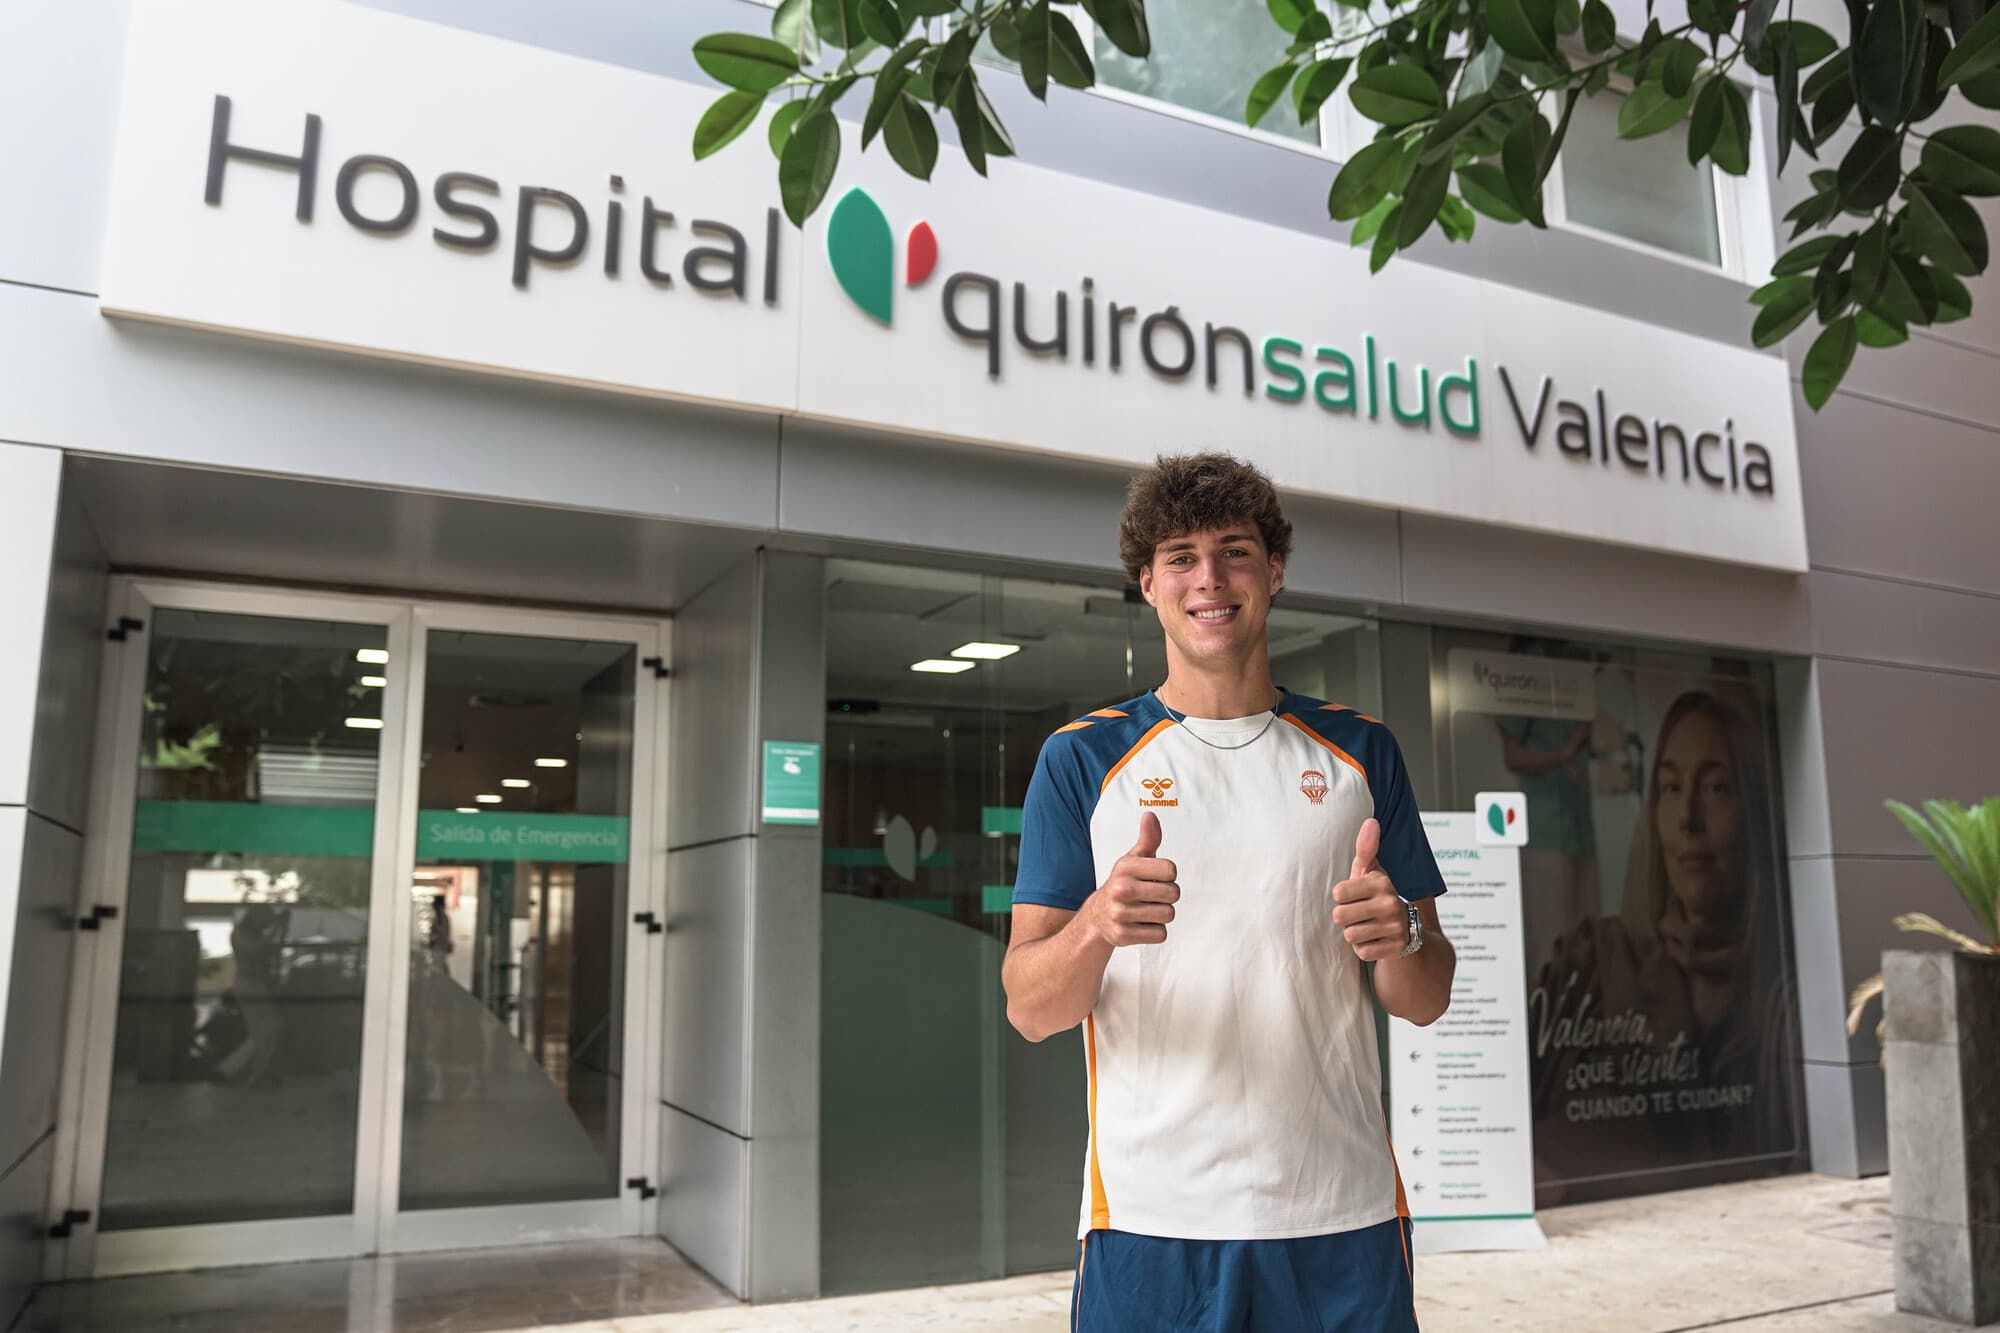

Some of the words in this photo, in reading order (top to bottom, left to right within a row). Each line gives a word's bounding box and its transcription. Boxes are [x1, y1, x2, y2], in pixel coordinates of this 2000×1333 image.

[204, 94, 781, 308] Hospital
[942, 272, 1481, 444] quirónsalud
[1498, 366, 1775, 498] Valencia
[1139, 797, 1178, 807] hummel
[430, 823, 485, 843] Salida
[490, 826, 512, 844] de
[517, 826, 618, 848] Emergencia
[1530, 971, 1654, 1058] Valencia,
[1619, 1031, 1700, 1085] sientes
[1566, 1094, 1648, 1121] CUANDO
[1651, 1090, 1673, 1113] TE
[1677, 1084, 1753, 1112] CUIDAN?
